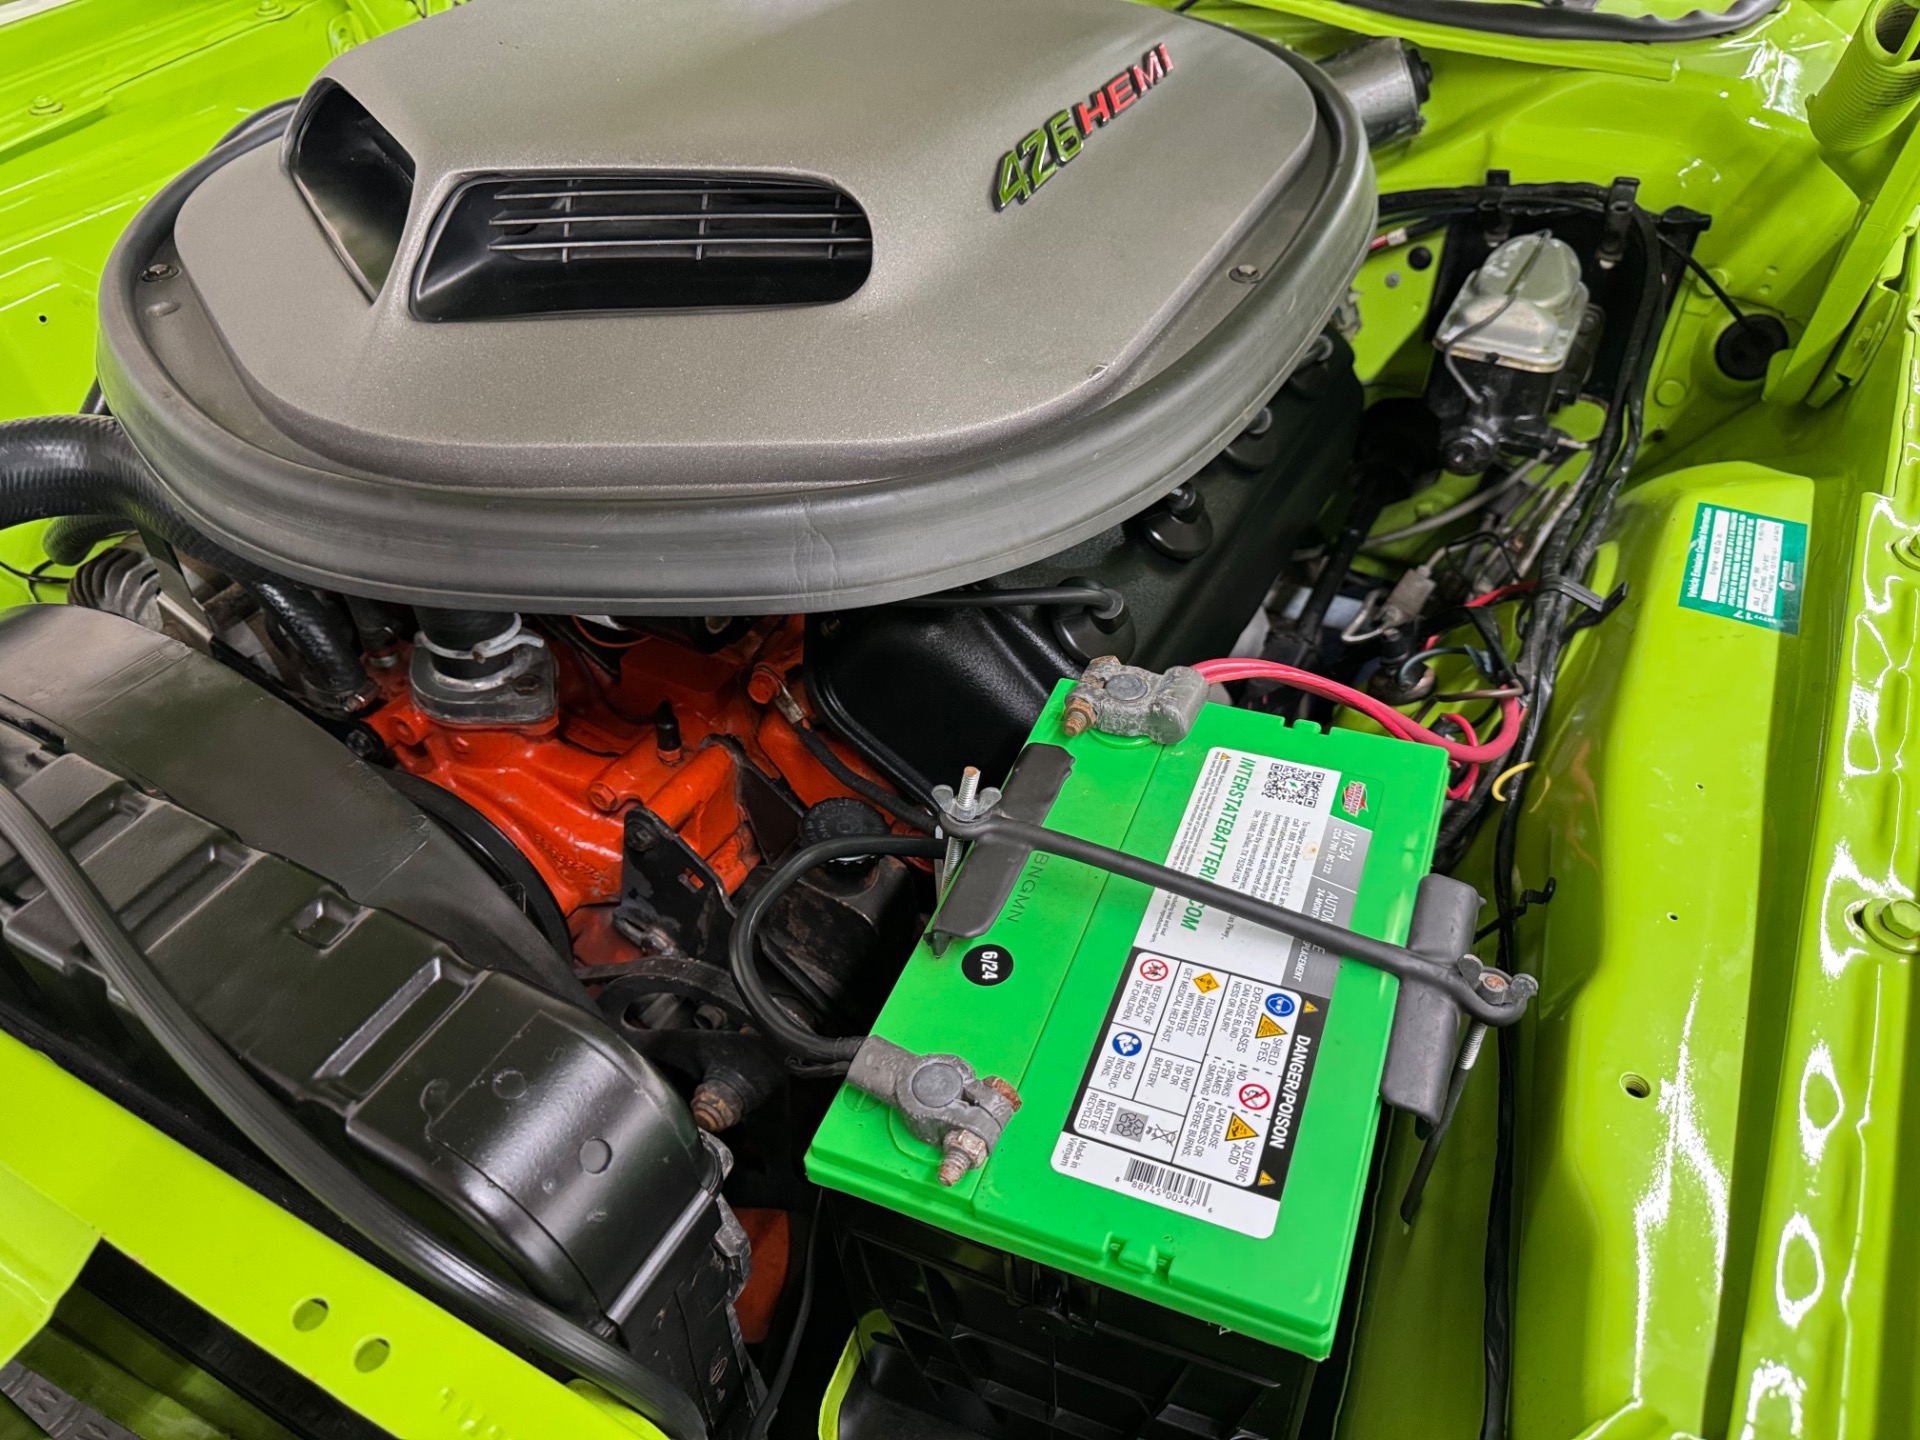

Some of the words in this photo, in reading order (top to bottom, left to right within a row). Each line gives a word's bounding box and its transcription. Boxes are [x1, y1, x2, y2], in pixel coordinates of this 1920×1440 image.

[994, 110, 1084, 211] 426
[1073, 43, 1173, 138] HEMI
[1331, 827, 1342, 840] CCA
[1336, 830, 1357, 861] MT-34
[1322, 862, 1332, 874] 122
[1325, 853, 1334, 862] RC
[1006, 853, 1050, 923] BNGMN
[980, 950, 999, 980] 6/24
[1182, 967, 1193, 980] GET
[1132, 979, 1143, 989] OF
[1141, 982, 1152, 995] THE
[1149, 984, 1163, 1002] KEEP
[1172, 980, 1189, 1008] MEDICAL
[1229, 980, 1242, 998] NESS
[1240, 983, 1252, 997] CAN
[1120, 988, 1139, 1022] CHILDREN.
[1133, 994, 1148, 1017] REACH
[1144, 1001, 1157, 1016] OUT
[1182, 991, 1196, 1009] WITH
[1201, 997, 1215, 1019] FLUSH
[1226, 997, 1237, 1008] OR
[1234, 996, 1248, 1018] CAUSE
[1243, 986, 1264, 1027] EXPLOSIVE
[1141, 1015, 1152, 1025] OF
[1166, 1007, 1179, 1026] HELP
[1174, 1008, 1190, 1033] WATER.
[1184, 994, 1206, 1036] IMMEDIATELY
[1218, 1007, 1233, 1033] INJURY.
[1160, 1024, 1173, 1043] FAST.
[1196, 1019, 1208, 1037] EYES
[1235, 1026, 1252, 1053] GASES
[1255, 1041, 1270, 1064] EYES.
[1266, 1037, 1283, 1066] SHIELD
[1099, 1054, 1115, 1078] TIONS.
[1106, 1057, 1125, 1091] INSTRUC-
[1121, 1060, 1135, 1080] READ
[1144, 1056, 1163, 1089] BATTERY.
[1159, 1059, 1173, 1079] OPEN
[1172, 1062, 1183, 1075] TIP
[1183, 1065, 1194, 1077] DO
[1235, 1067, 1247, 1081] NO
[1168, 1073, 1180, 1086] OR
[1178, 1076, 1191, 1092] NOT
[1199, 1063, 1217, 1096] SMOKING
[1210, 1065, 1226, 1095] FLAMES
[1219, 1068, 1236, 1097] SPARKS
[1267, 1033, 1312, 1149] DANGER/POISON
[1076, 1091, 1099, 1131] RECYCLED.
[1091, 1098, 1107, 1120] MUST
[1096, 1101, 1116, 1135] BATTERY
[1189, 1100, 1205, 1129] SEVERE
[1214, 1107, 1227, 1124] CAN
[1087, 1119, 1099, 1131] BE
[1196, 1104, 1216, 1146] BLINDNESS
[1206, 1123, 1222, 1149] CAUSE
[1059, 1136, 1078, 1167] Vietnam
[1072, 1139, 1087, 1161] Made
[1180, 1128, 1197, 1158] BURNS.
[1192, 1144, 1204, 1157] OR
[1226, 1142, 1242, 1166] ACID
[1069, 1160, 1080, 1169] in
[1234, 1139, 1255, 1183] SULFURIC
[1130, 1180, 1161, 1196] 88745
[1164, 1191, 1196, 1208] 00347
